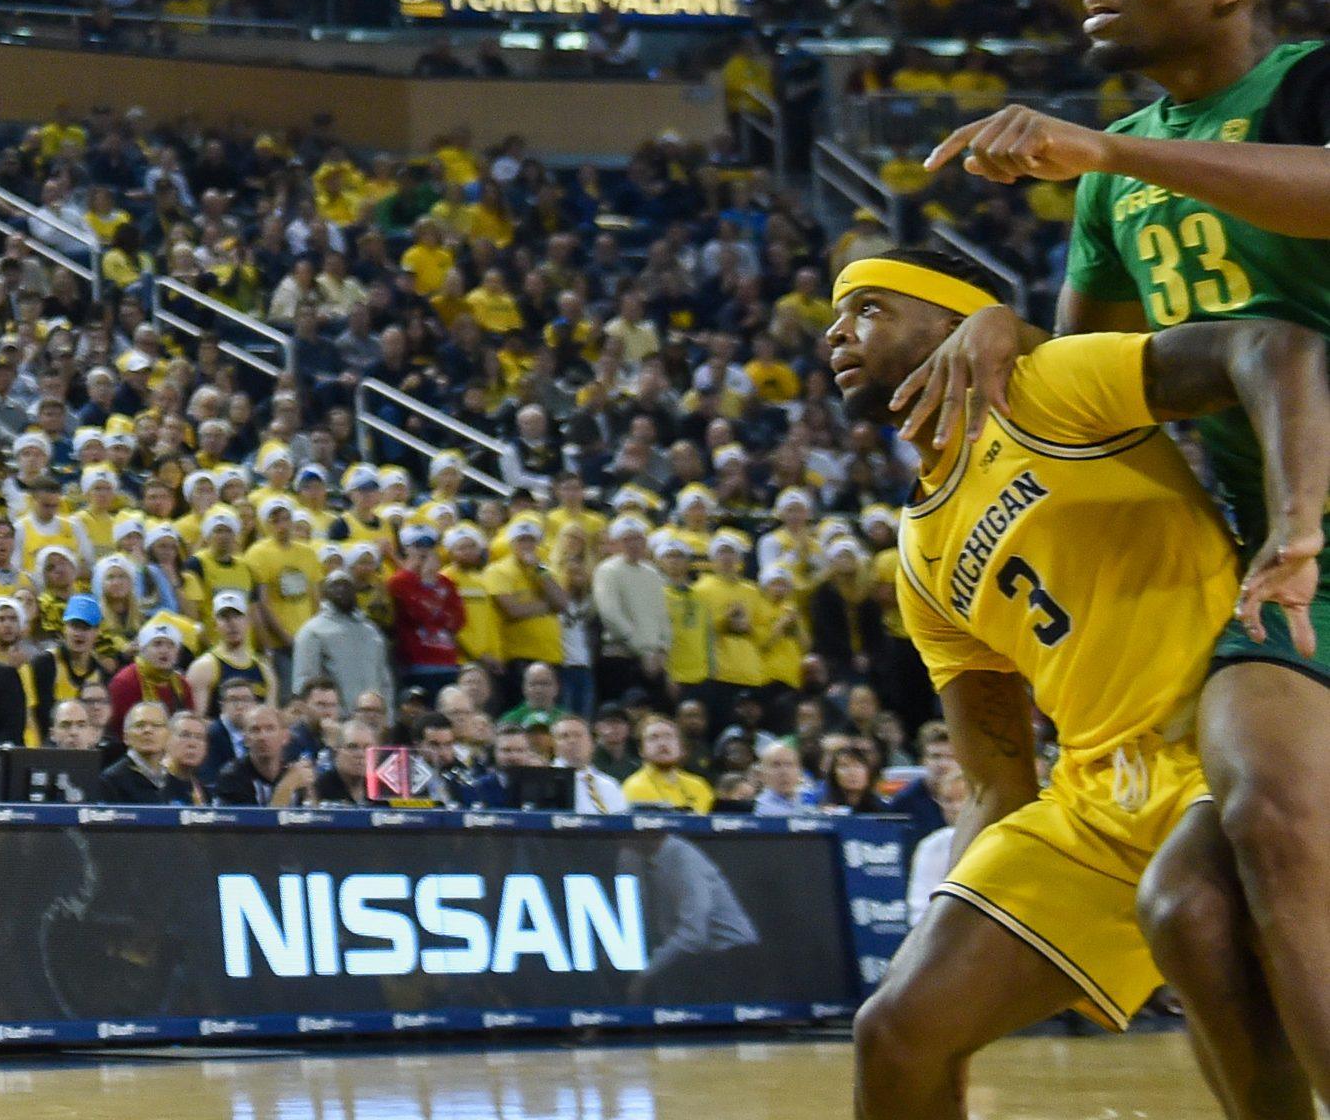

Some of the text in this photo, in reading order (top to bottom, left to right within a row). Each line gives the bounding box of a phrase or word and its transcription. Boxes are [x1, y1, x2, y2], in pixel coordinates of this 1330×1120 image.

[1137, 212, 1252, 326] 33
[949, 470, 1050, 622] MICHIGAN
[995, 554, 1072, 648] 3
[217, 873, 649, 978] NISSAN
